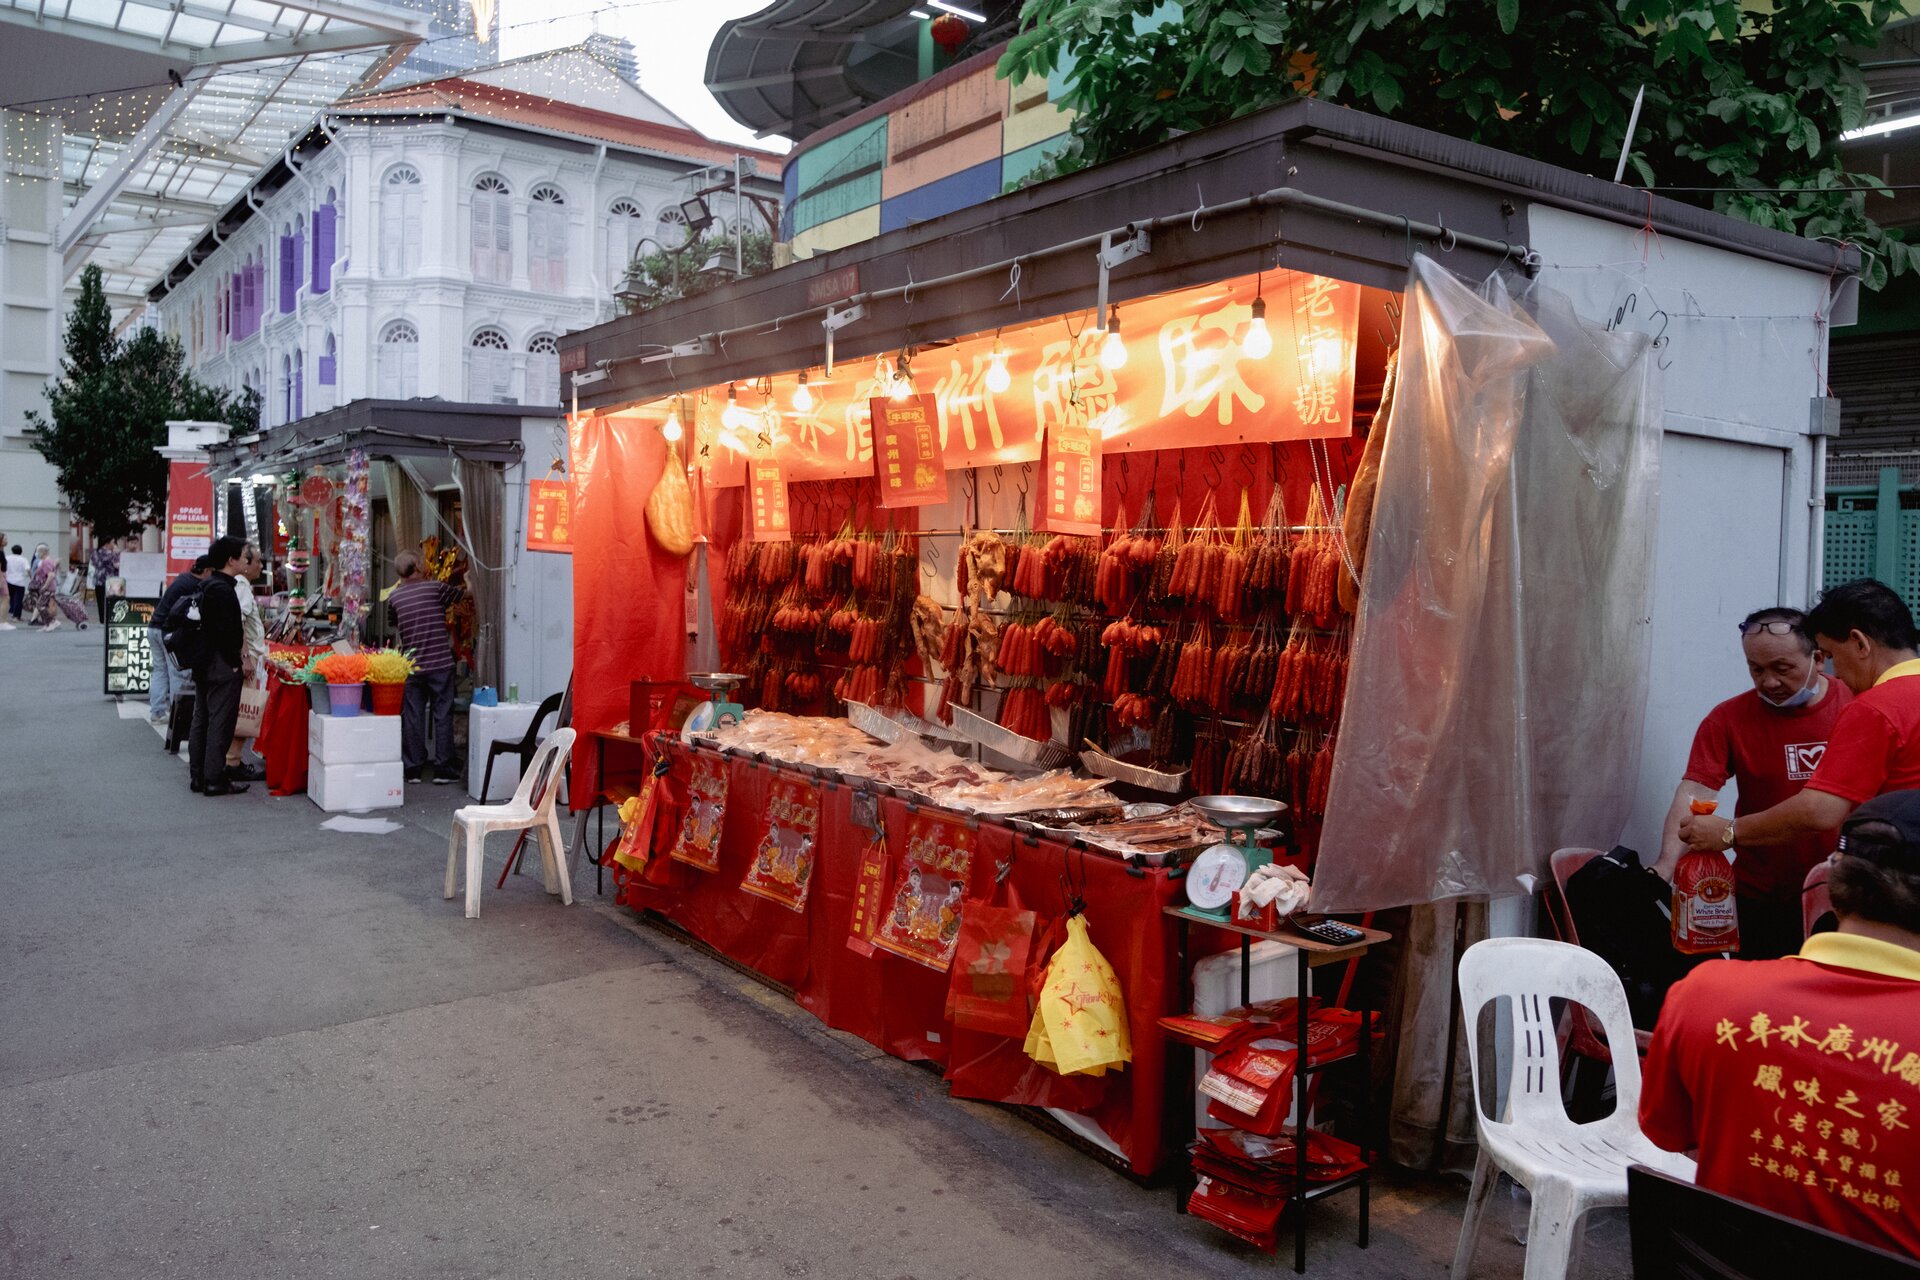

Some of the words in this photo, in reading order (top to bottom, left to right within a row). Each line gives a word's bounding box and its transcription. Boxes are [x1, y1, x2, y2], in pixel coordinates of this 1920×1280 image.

[809, 277, 840, 301] SMSA
[842, 272, 855, 292] 07
[180, 507, 203, 515] SPACE
[188, 514, 209, 522] LEASE
[128, 626, 141, 691] HENNA
